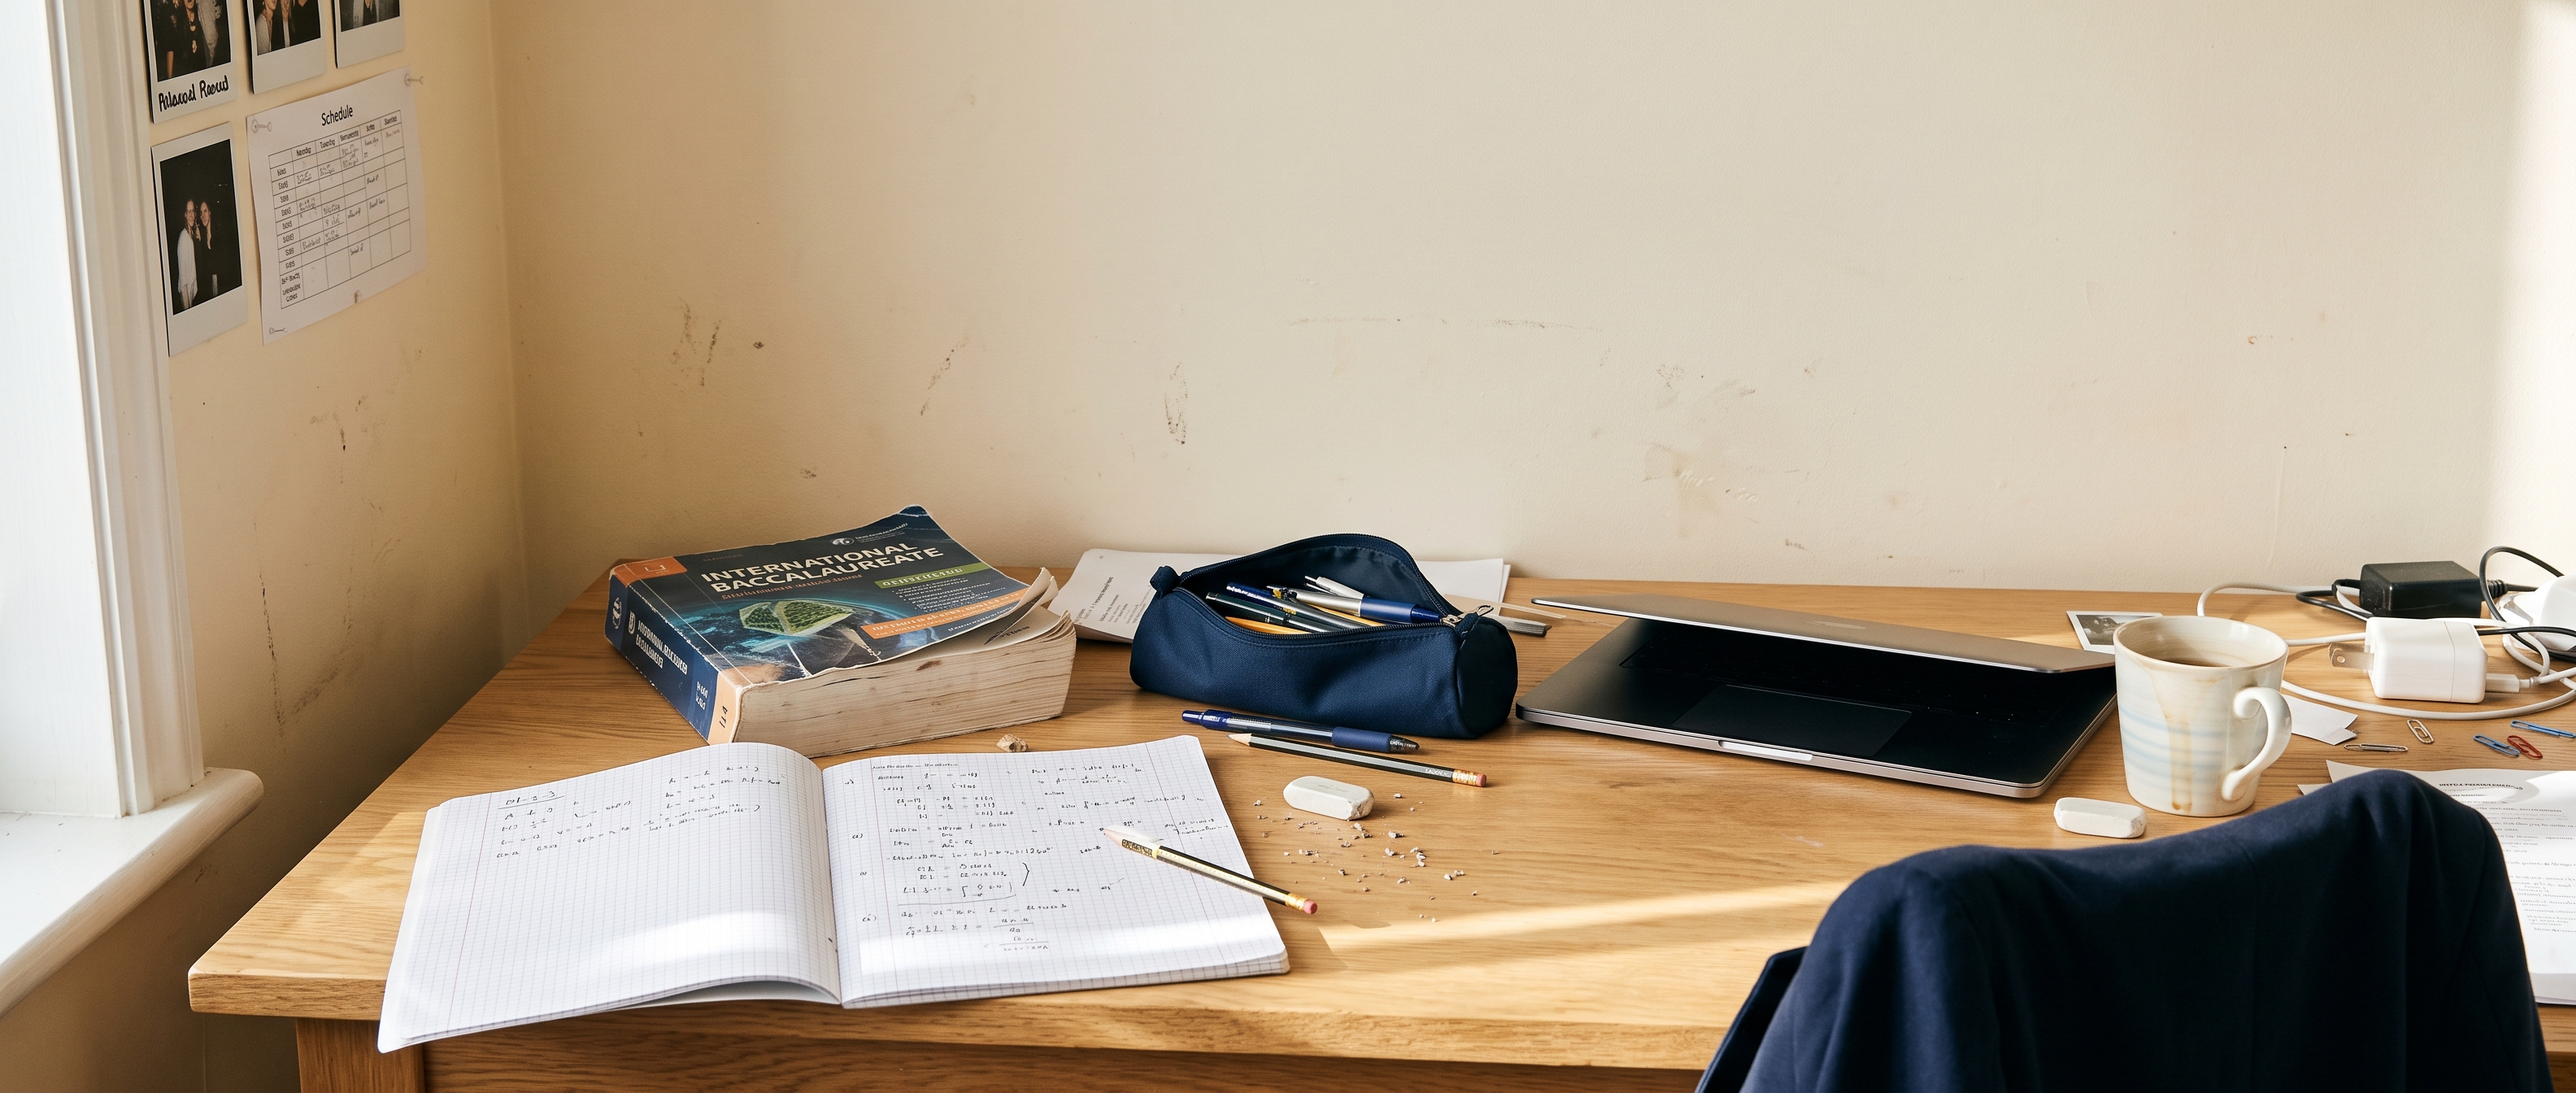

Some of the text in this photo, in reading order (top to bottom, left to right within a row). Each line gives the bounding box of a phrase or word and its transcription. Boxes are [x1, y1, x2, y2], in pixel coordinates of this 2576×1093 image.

[321, 105, 353, 126] Schedule
[701, 542, 918, 582] INTERNATIONAL
[710, 547, 943, 593] BACCALAUREATE
